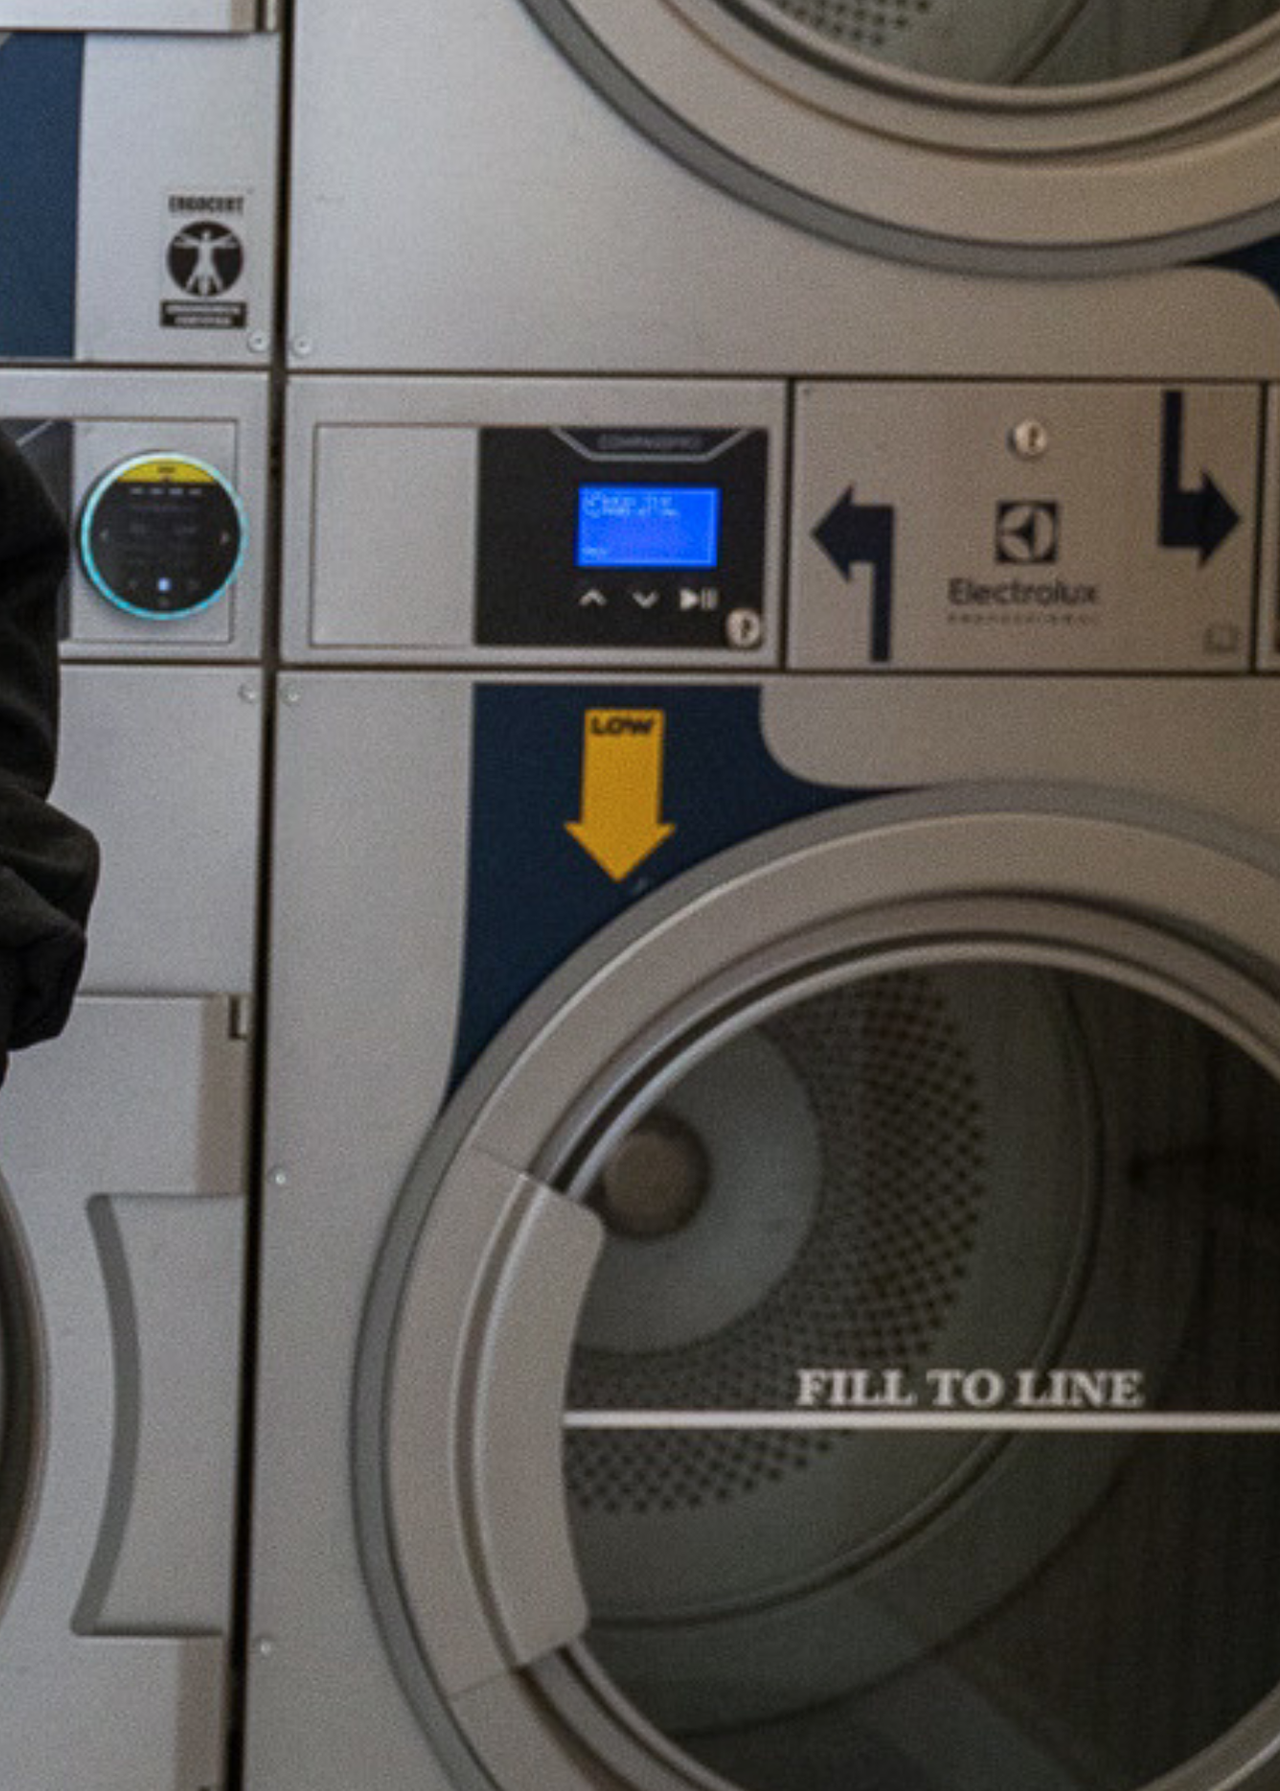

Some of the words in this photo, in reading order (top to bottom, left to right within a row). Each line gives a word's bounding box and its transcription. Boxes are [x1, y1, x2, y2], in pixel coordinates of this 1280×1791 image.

[946, 577, 1097, 606] Electrolux
[590, 716, 655, 736] LOW
[796, 1368, 917, 1407] FILL
[926, 1370, 1005, 1407] TO
[1014, 1371, 1144, 1408] LINE
